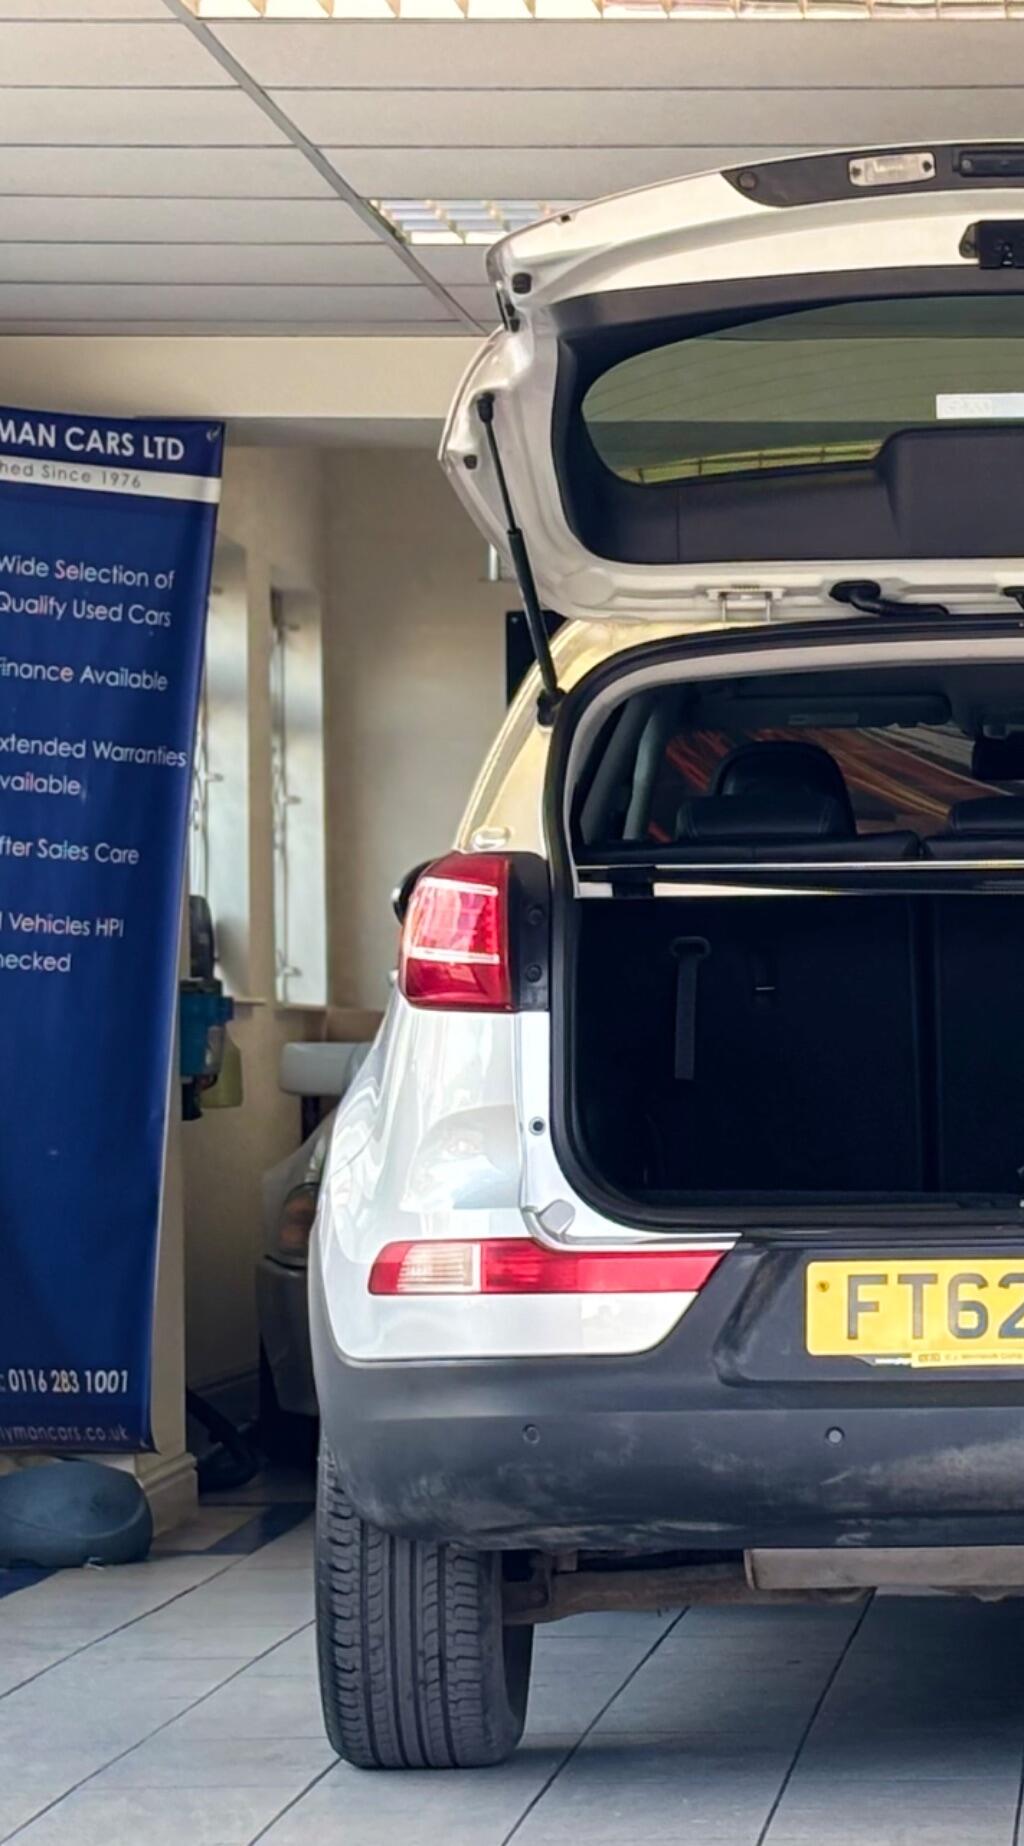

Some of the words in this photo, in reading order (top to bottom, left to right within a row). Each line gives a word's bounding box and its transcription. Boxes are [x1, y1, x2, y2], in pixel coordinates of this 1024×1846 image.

[0, 418, 56, 448] MAN
[65, 427, 134, 457] CARS
[143, 435, 184, 461] LTD
[42, 462, 91, 483] Since
[102, 473, 141, 489] 1976
[54, 559, 149, 587] Selection
[154, 570, 175, 589] of
[72, 599, 123, 622] Used
[128, 604, 171, 627] Cars
[80, 665, 168, 691] Available
[92, 740, 187, 767] Warranties
[37, 838, 89, 861] Sales
[94, 842, 140, 865] Care
[9, 911, 90, 936] Vehicles
[95, 917, 124, 938] HPI
[8, 1368, 47, 1393] 0116
[51, 1368, 80, 1393] 283
[84, 1370, 129, 1394] 1001
